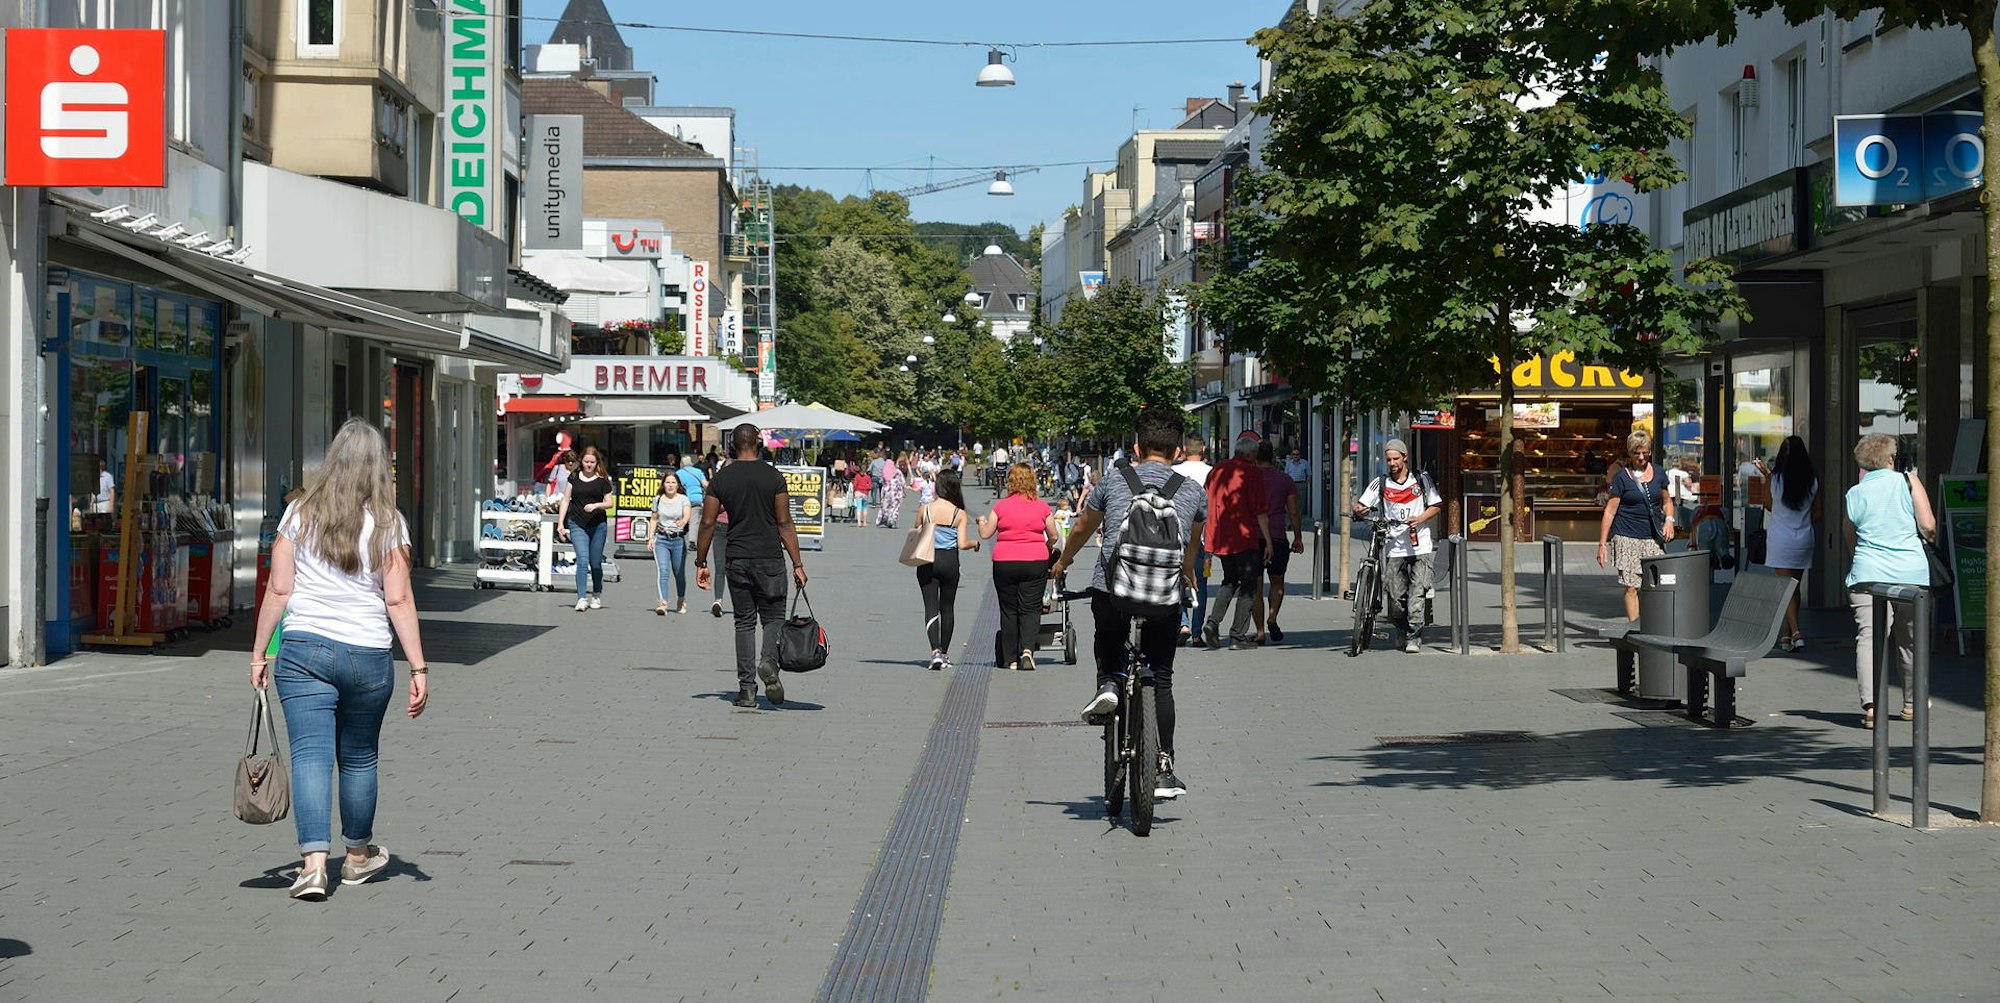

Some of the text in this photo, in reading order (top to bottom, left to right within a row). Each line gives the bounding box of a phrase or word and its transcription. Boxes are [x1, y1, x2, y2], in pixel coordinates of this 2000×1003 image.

[543, 126, 565, 238] unitymedia
[1726, 186, 1795, 252] LEVERKUSEN
[640, 239, 659, 253] TUI
[595, 365, 707, 388] BREMER
[633, 467, 657, 478] HIER
[782, 472, 821, 485] GOLD
[787, 483, 821, 492] NKAUF
[1400, 508, 1411, 519] 87
